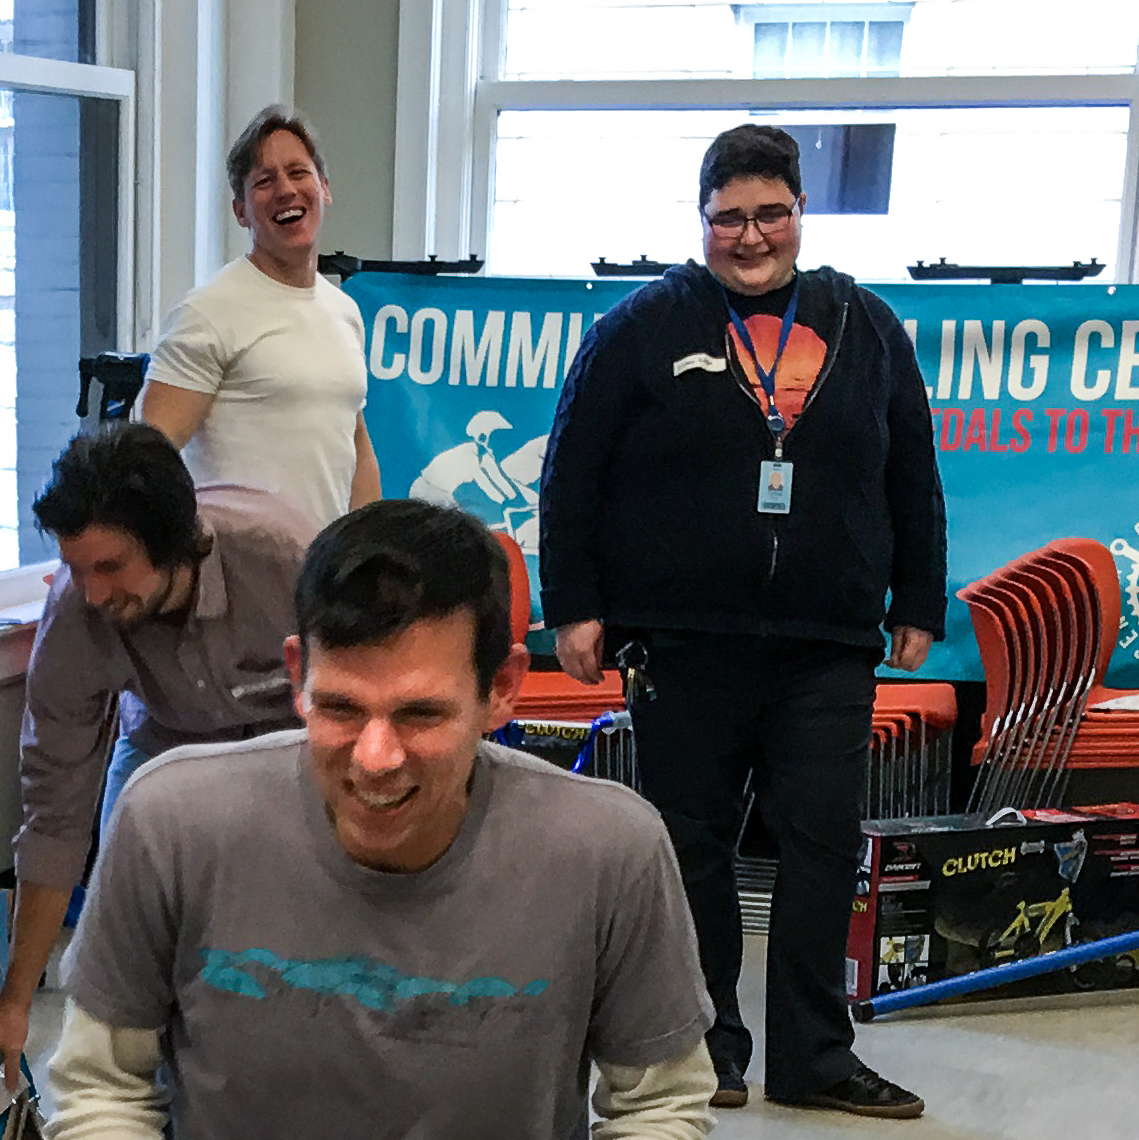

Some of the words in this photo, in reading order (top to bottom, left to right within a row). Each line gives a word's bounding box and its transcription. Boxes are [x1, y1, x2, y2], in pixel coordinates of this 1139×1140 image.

[905, 319, 1051, 401] ING
[931, 407, 1034, 452] DALS
[1044, 407, 1090, 452] TO
[942, 846, 1017, 877] CLUTCH
